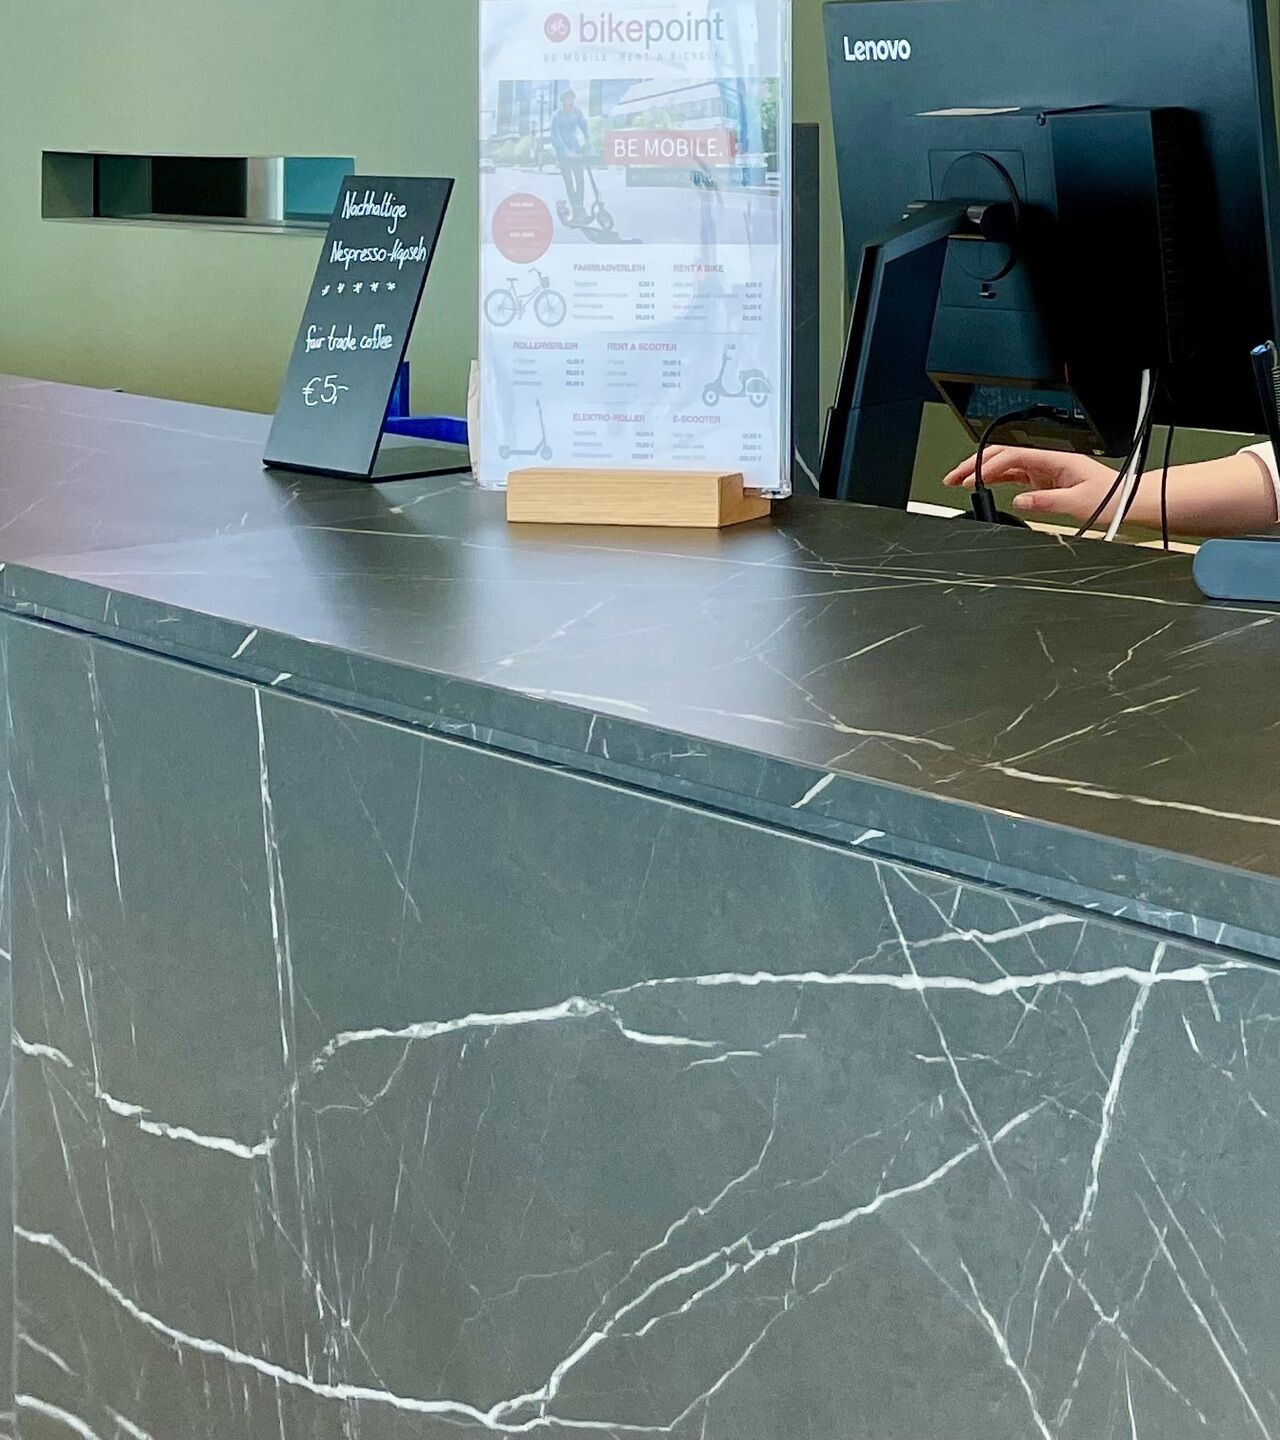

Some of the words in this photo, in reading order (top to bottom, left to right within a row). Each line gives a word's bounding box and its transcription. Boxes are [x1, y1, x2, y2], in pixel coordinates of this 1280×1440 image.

[579, 11, 724, 50] bikepoint
[843, 35, 911, 61] Lenovo
[614, 138, 639, 157] BE
[644, 137, 723, 157] MOBILE.
[341, 190, 407, 234] Nachhaltige
[329, 235, 427, 271] Nespresso-Kapseln
[328, 324, 357, 351] trade
[360, 323, 393, 349] coffee
[630, 343, 637, 351] A
